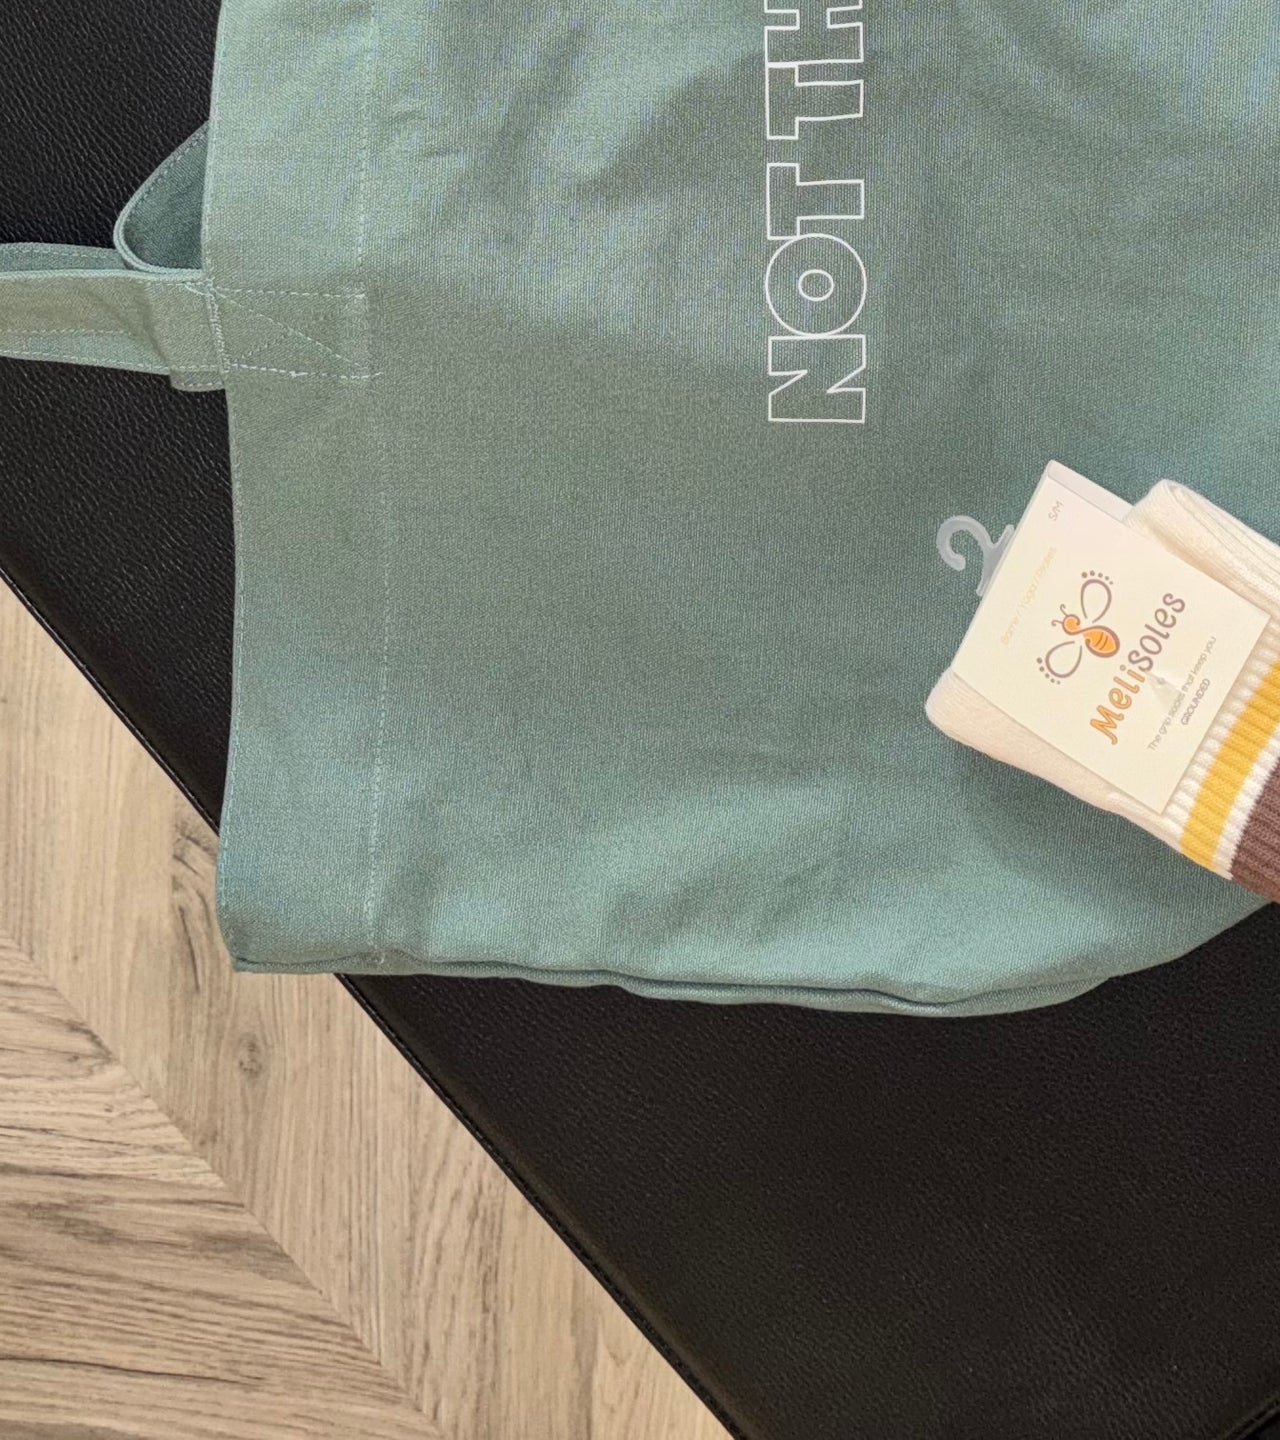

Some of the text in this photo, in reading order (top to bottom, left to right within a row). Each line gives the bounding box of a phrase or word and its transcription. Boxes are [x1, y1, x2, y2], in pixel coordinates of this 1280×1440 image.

[765, 162, 867, 424] NOT
[1047, 500, 1064, 522] S/M
[1147, 734, 1162, 751] The
[1158, 717, 1172, 736] grip
[1181, 675, 1194, 693] that
[1191, 653, 1208, 676] keep
[1205, 636, 1217, 655] you
[1180, 678, 1211, 726] GROUNDED
